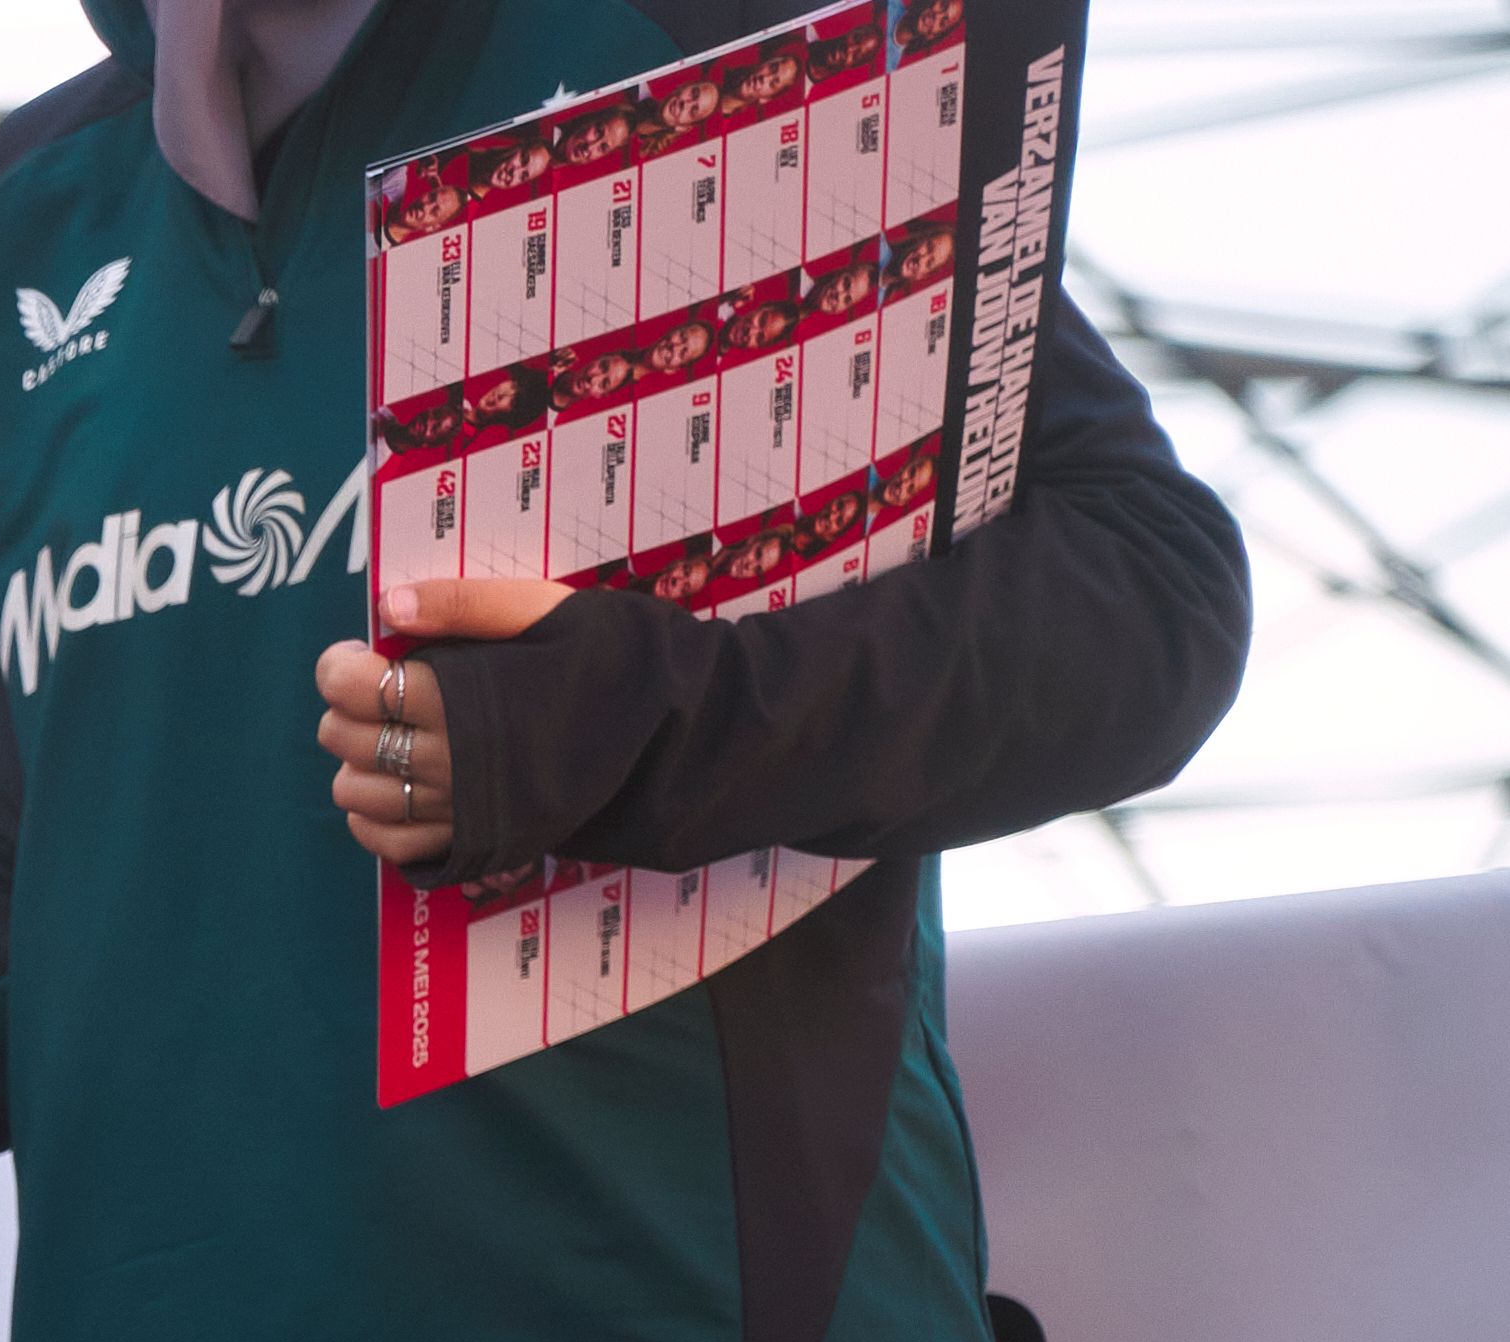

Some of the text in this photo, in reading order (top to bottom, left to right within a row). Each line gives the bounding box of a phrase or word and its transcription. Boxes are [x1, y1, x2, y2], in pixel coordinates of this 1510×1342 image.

[861, 93, 880, 109] 5
[780, 118, 799, 145] 18
[697, 154, 716, 169] 7
[1012, 43, 1065, 284] VERZAMEL
[613, 179, 632, 204] 21
[527, 207, 547, 232] 19
[442, 234, 462, 263] 33
[1005, 273, 1044, 339] DE
[22, 330, 109, 392] CASTORE
[950, 164, 1021, 544] VAN JOUW HELDIN
[775, 356, 793, 383] 24
[692, 392, 711, 406] 9
[607, 414, 626, 439] 27
[522, 441, 541, 468] 23
[437, 470, 456, 497] 42
[414, 927, 430, 947] 3
[413, 948, 430, 999] MEI
[412, 1000, 430, 1068] 2025
